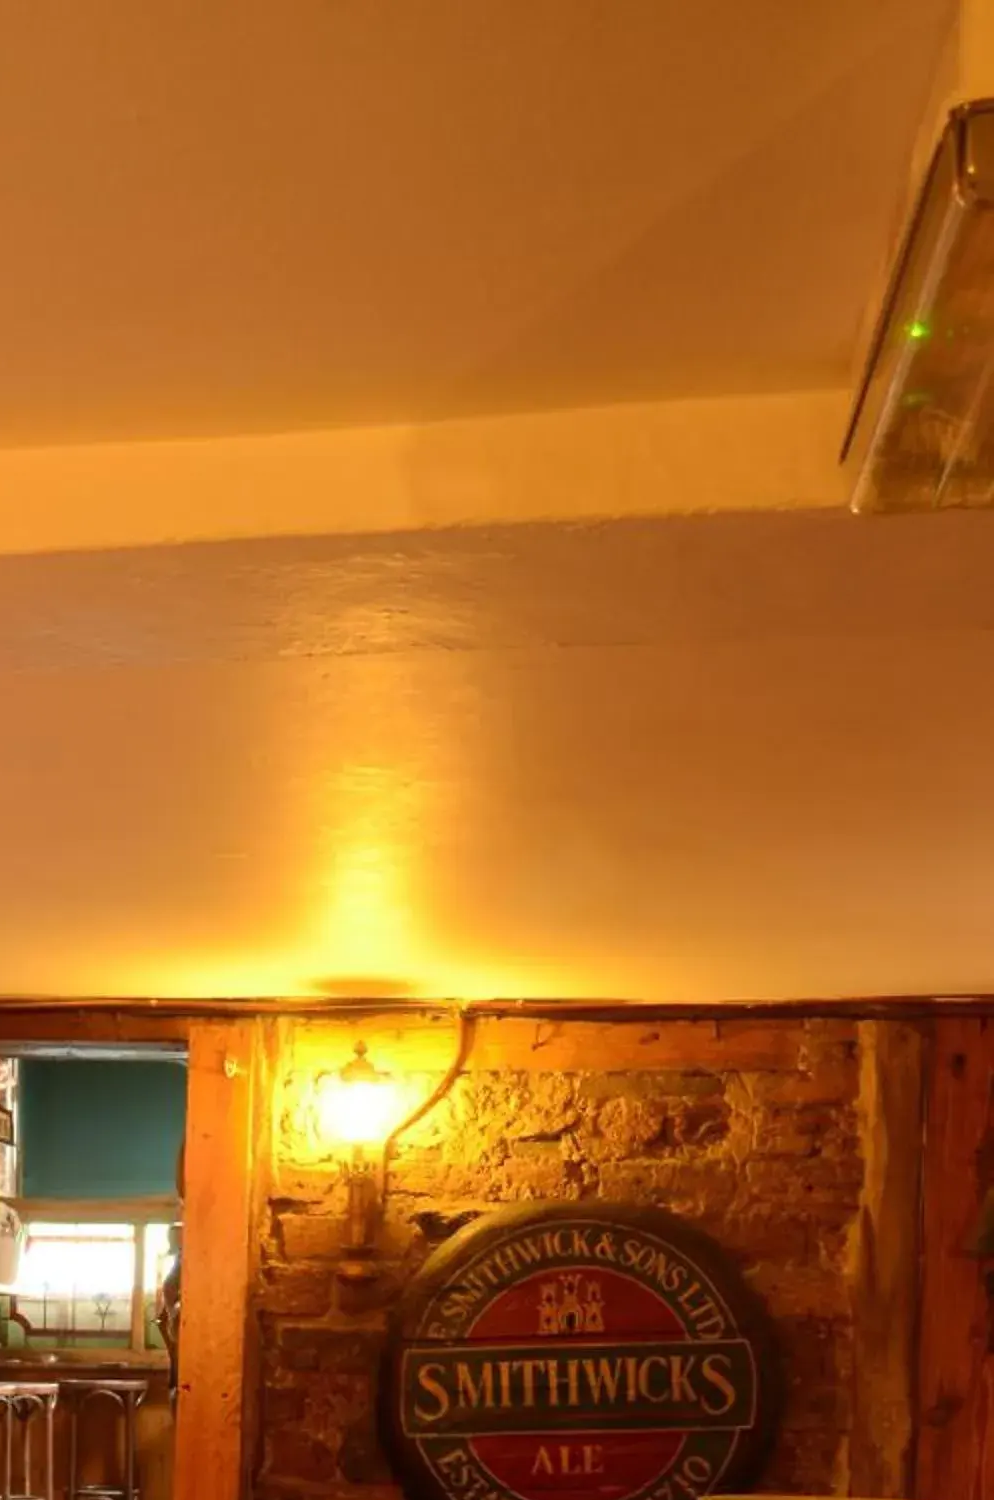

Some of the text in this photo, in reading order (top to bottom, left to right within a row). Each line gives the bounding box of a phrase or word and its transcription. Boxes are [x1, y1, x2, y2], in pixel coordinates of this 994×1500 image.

[440, 1228, 591, 1320] SMITHWICK
[594, 1231, 617, 1263] &
[619, 1239, 688, 1292] SONS
[677, 1281, 725, 1340] LTD
[413, 1353, 736, 1422] SMITHWICKS
[530, 1444, 605, 1477] ALE
